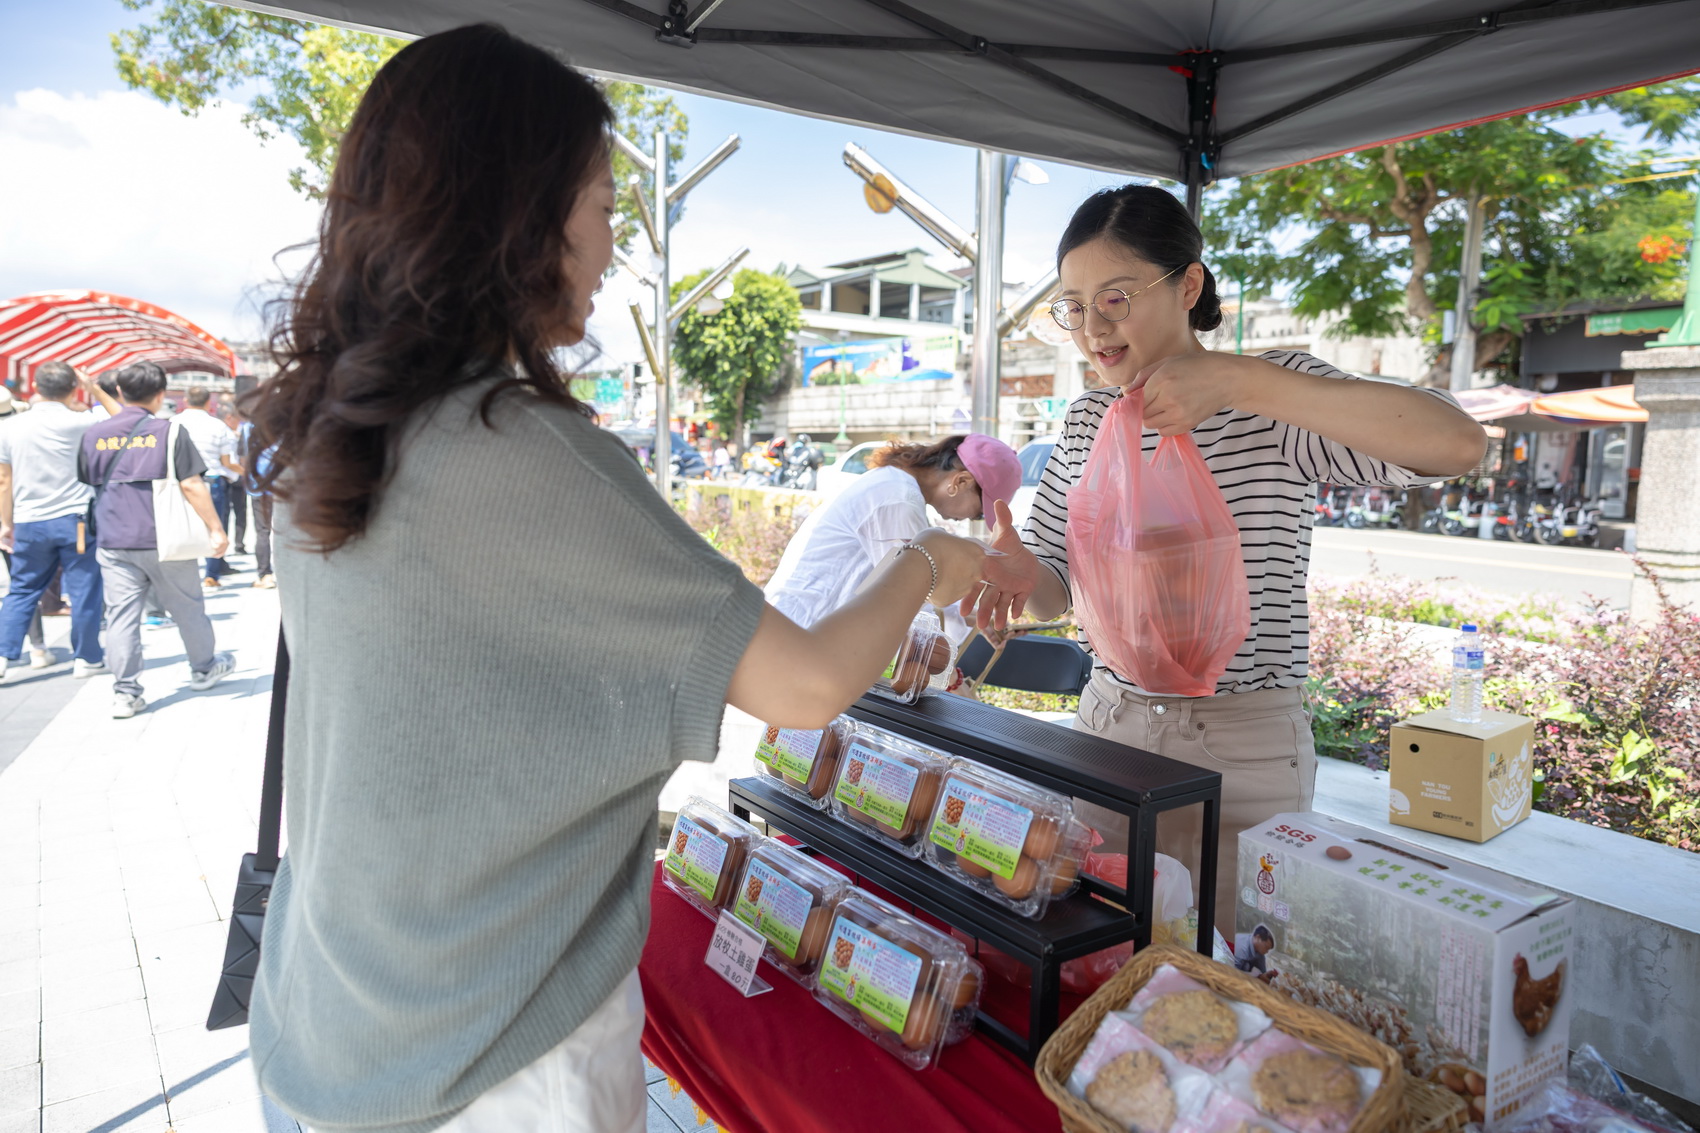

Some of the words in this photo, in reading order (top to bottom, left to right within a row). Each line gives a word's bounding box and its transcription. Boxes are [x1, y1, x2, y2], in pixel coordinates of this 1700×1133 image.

[1421, 791, 1452, 802] FARMERS
[1275, 825, 1317, 842] SGS
[713, 934, 755, 974] 放牧土雞蛋
